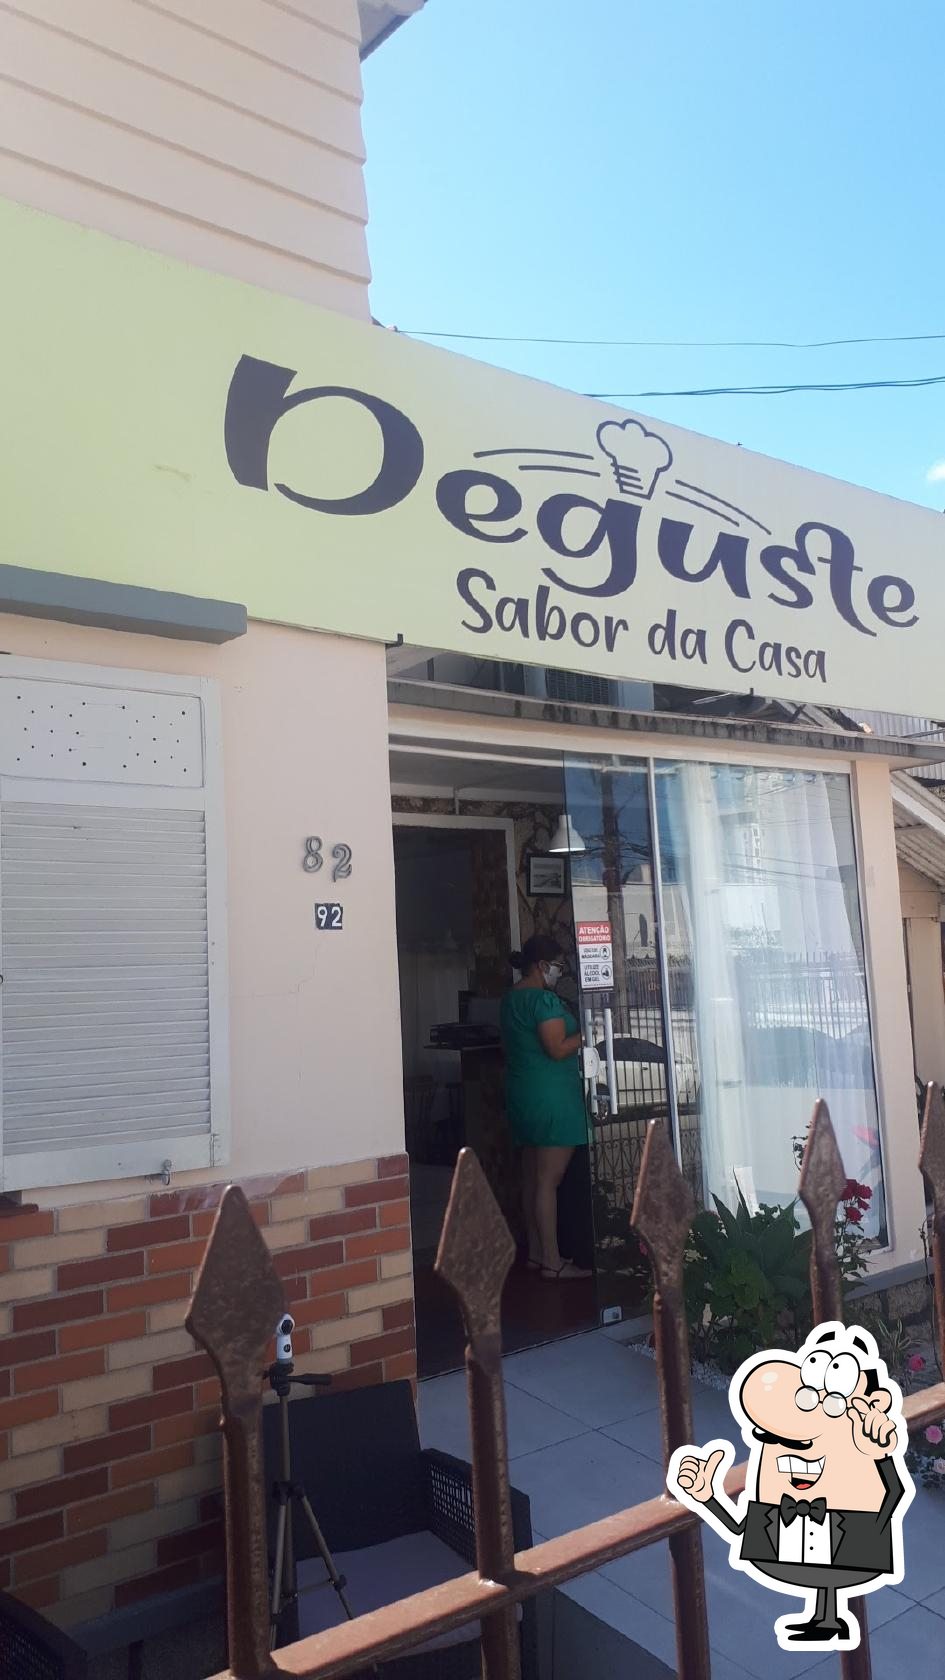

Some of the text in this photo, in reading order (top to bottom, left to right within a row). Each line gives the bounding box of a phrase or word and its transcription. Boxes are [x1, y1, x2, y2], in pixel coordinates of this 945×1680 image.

[224, 353, 920, 637] Deguste
[456, 567, 828, 684] Sabor da Casa
[302, 836, 352, 883] 82
[317, 906, 342, 927] 92
[579, 925, 609, 934] ATENÇÃO
